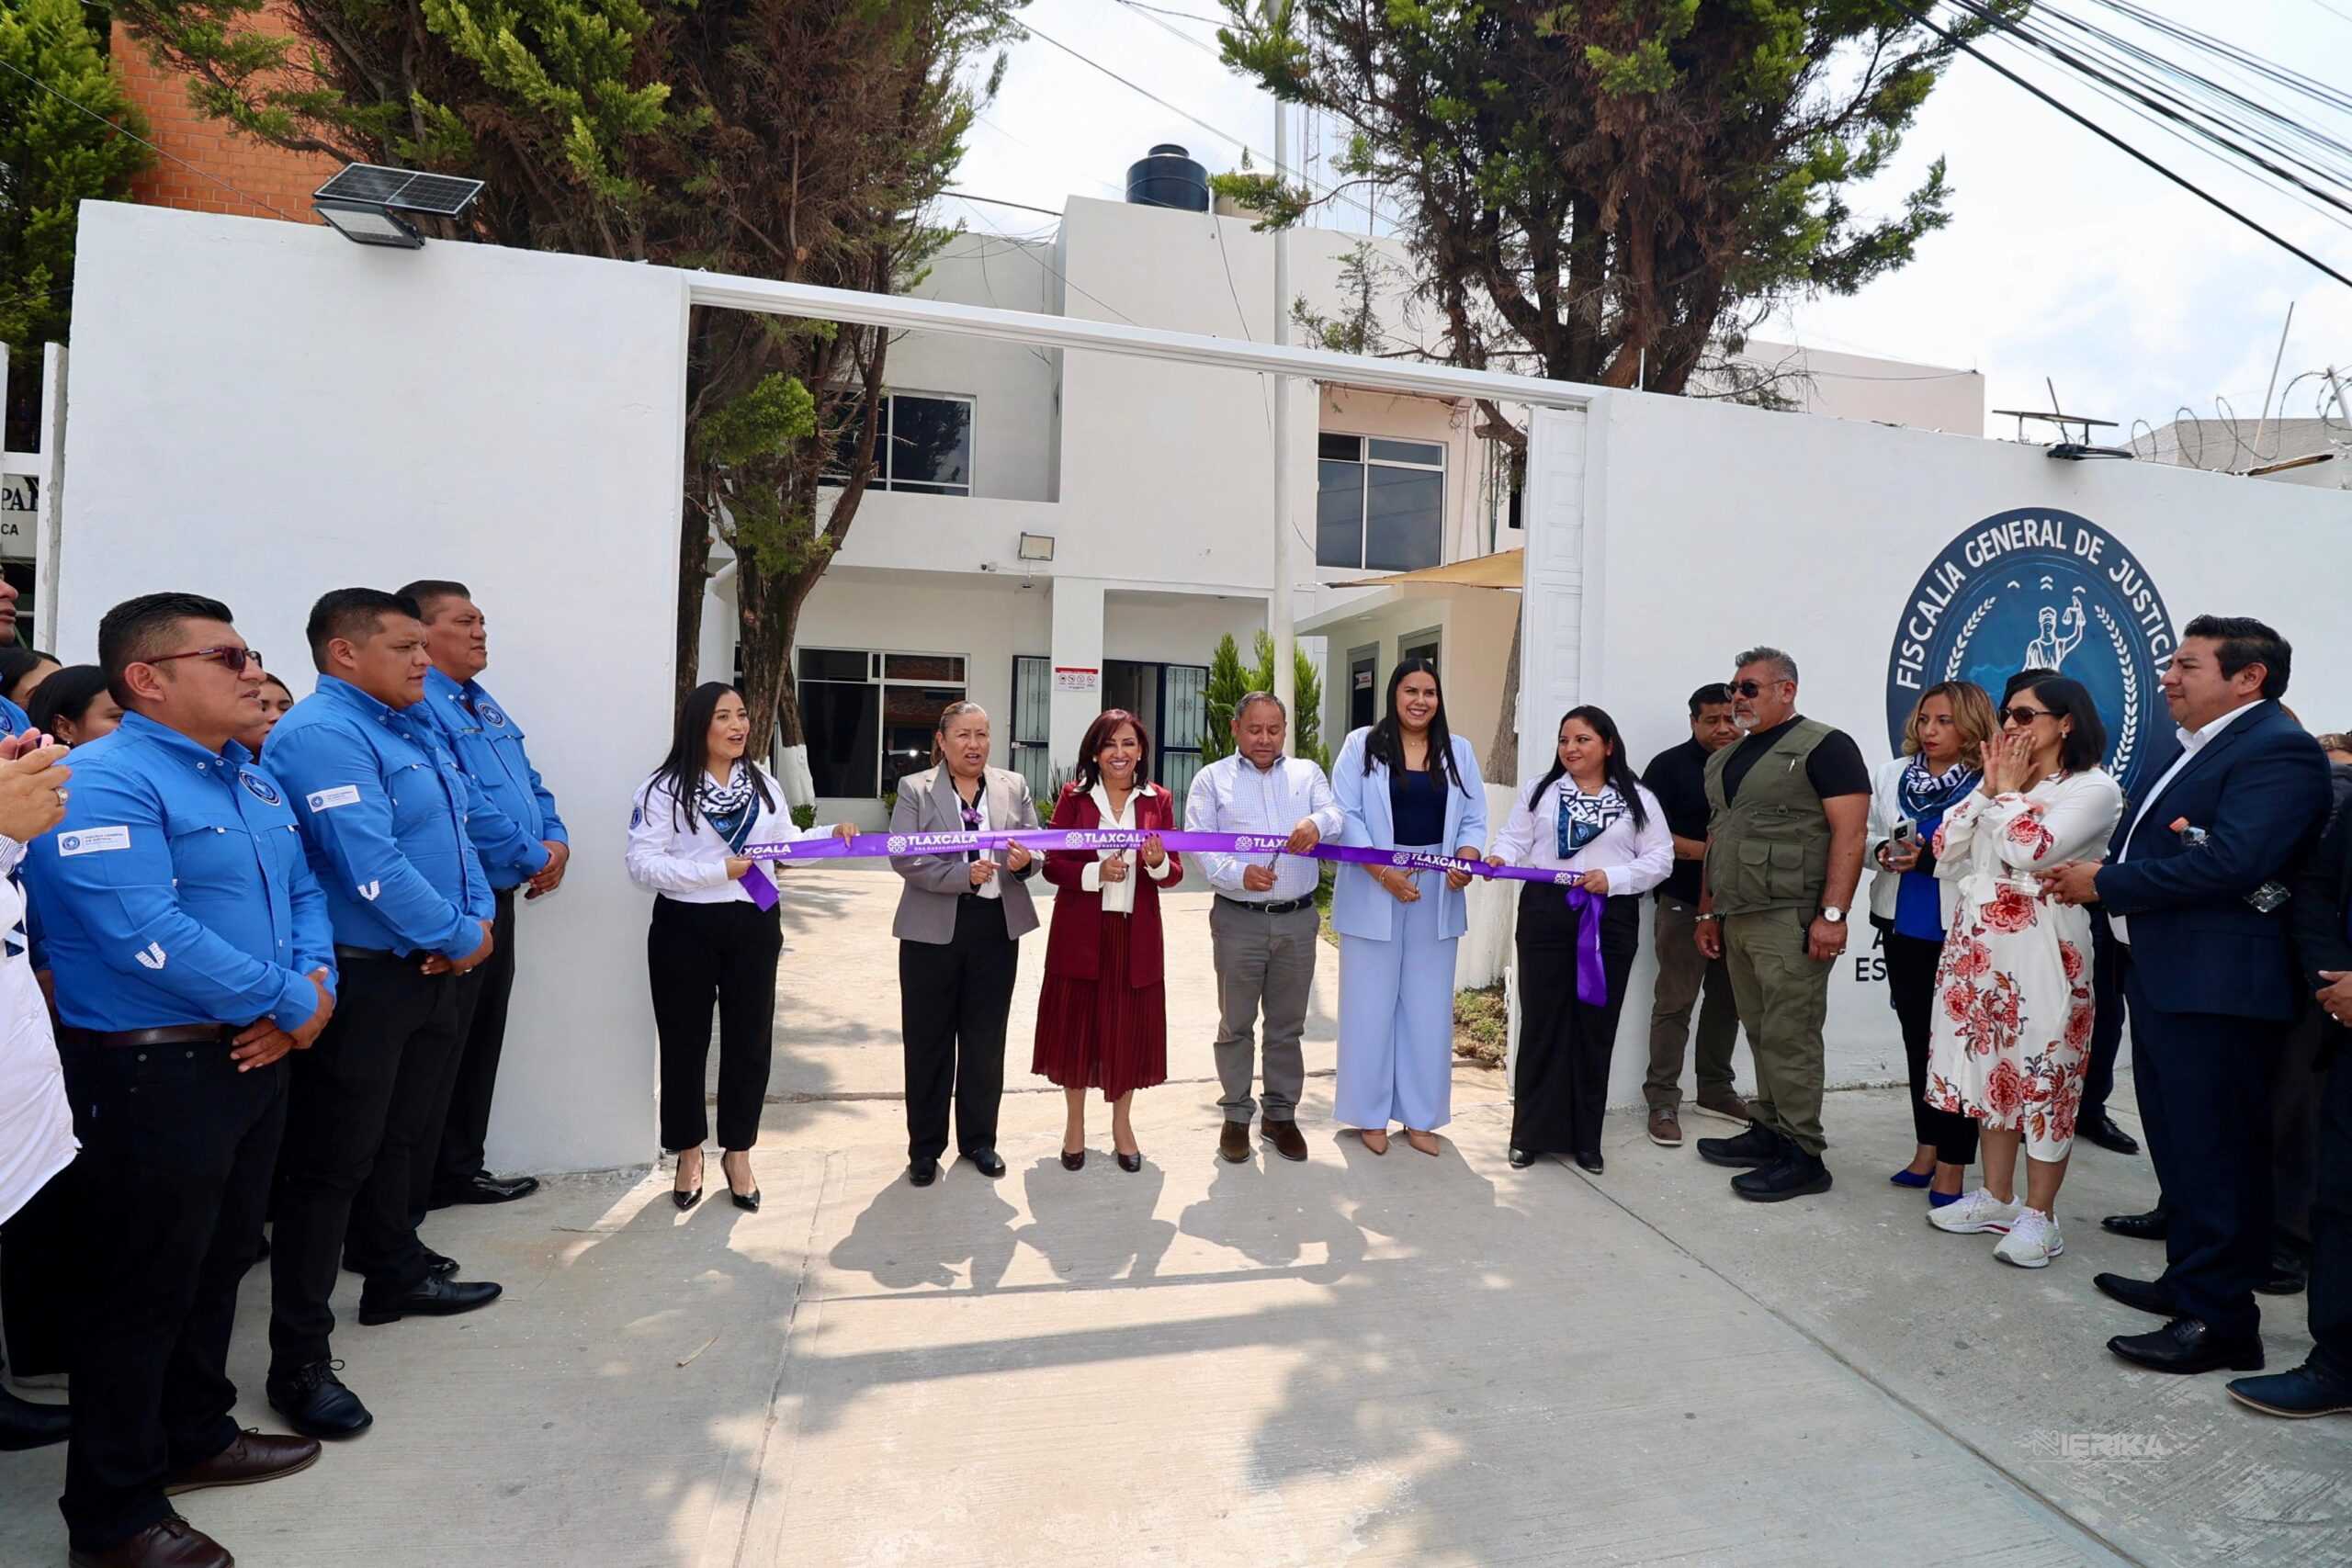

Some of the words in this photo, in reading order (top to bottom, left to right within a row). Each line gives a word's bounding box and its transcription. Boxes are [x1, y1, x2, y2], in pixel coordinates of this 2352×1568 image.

[1896, 560, 1966, 690] FISCALÍA
[1964, 519, 2067, 569] GENERAL
[2074, 527, 2105, 565] DE
[908, 833, 978, 846] TLAXCALA
[1084, 832, 1146, 843] TLAXCAL
[1411, 853, 1473, 873] TLAXCALA
